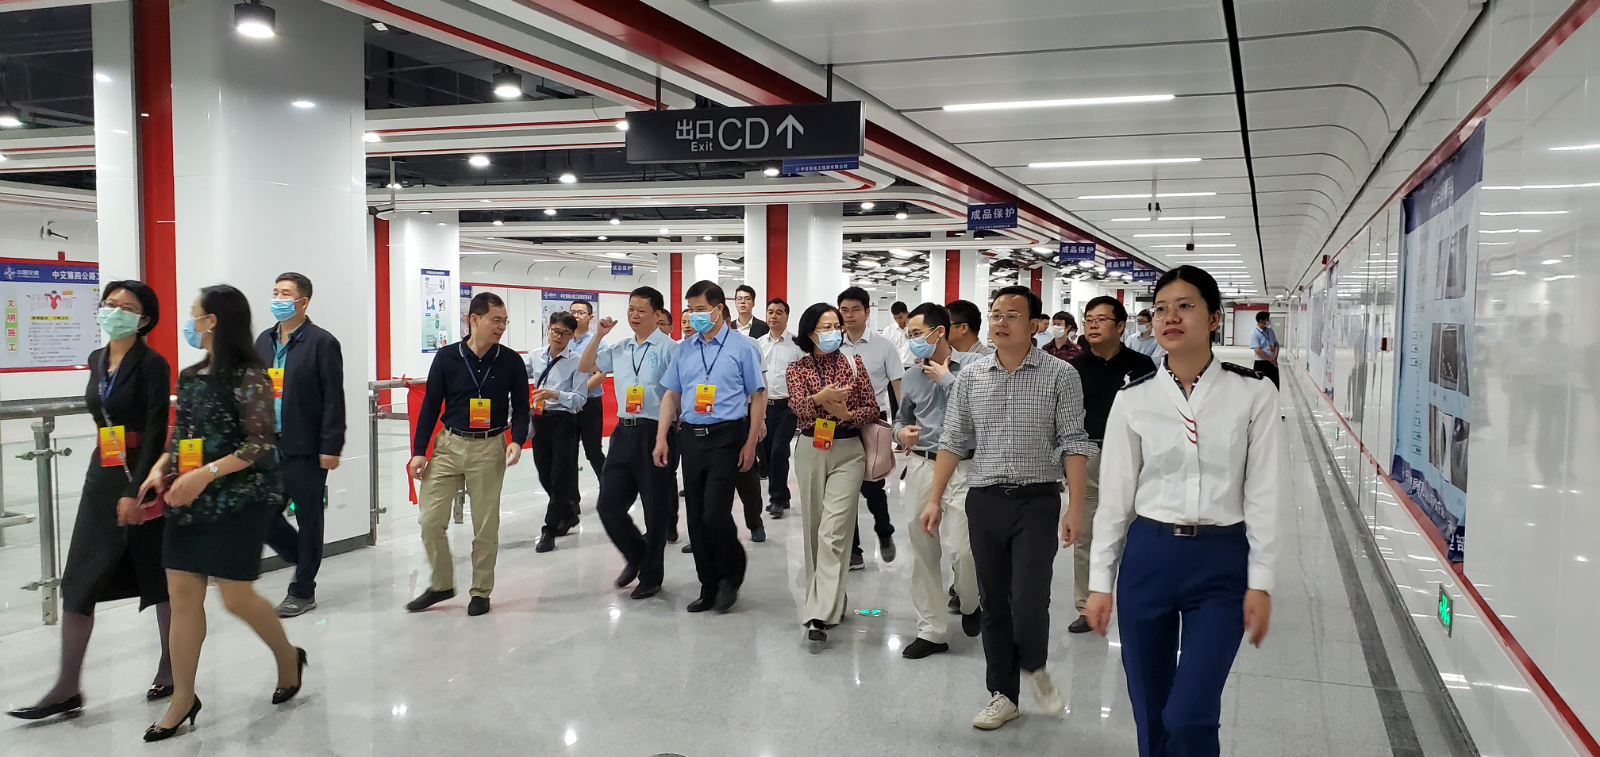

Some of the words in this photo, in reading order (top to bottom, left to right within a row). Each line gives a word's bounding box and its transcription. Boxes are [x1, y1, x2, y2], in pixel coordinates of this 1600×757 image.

[676, 118, 714, 140] 出口
[718, 117, 770, 151] CD
[690, 141, 714, 152] Exit
[970, 206, 1015, 221] 成品保护
[1062, 246, 1094, 254] 成品保护
